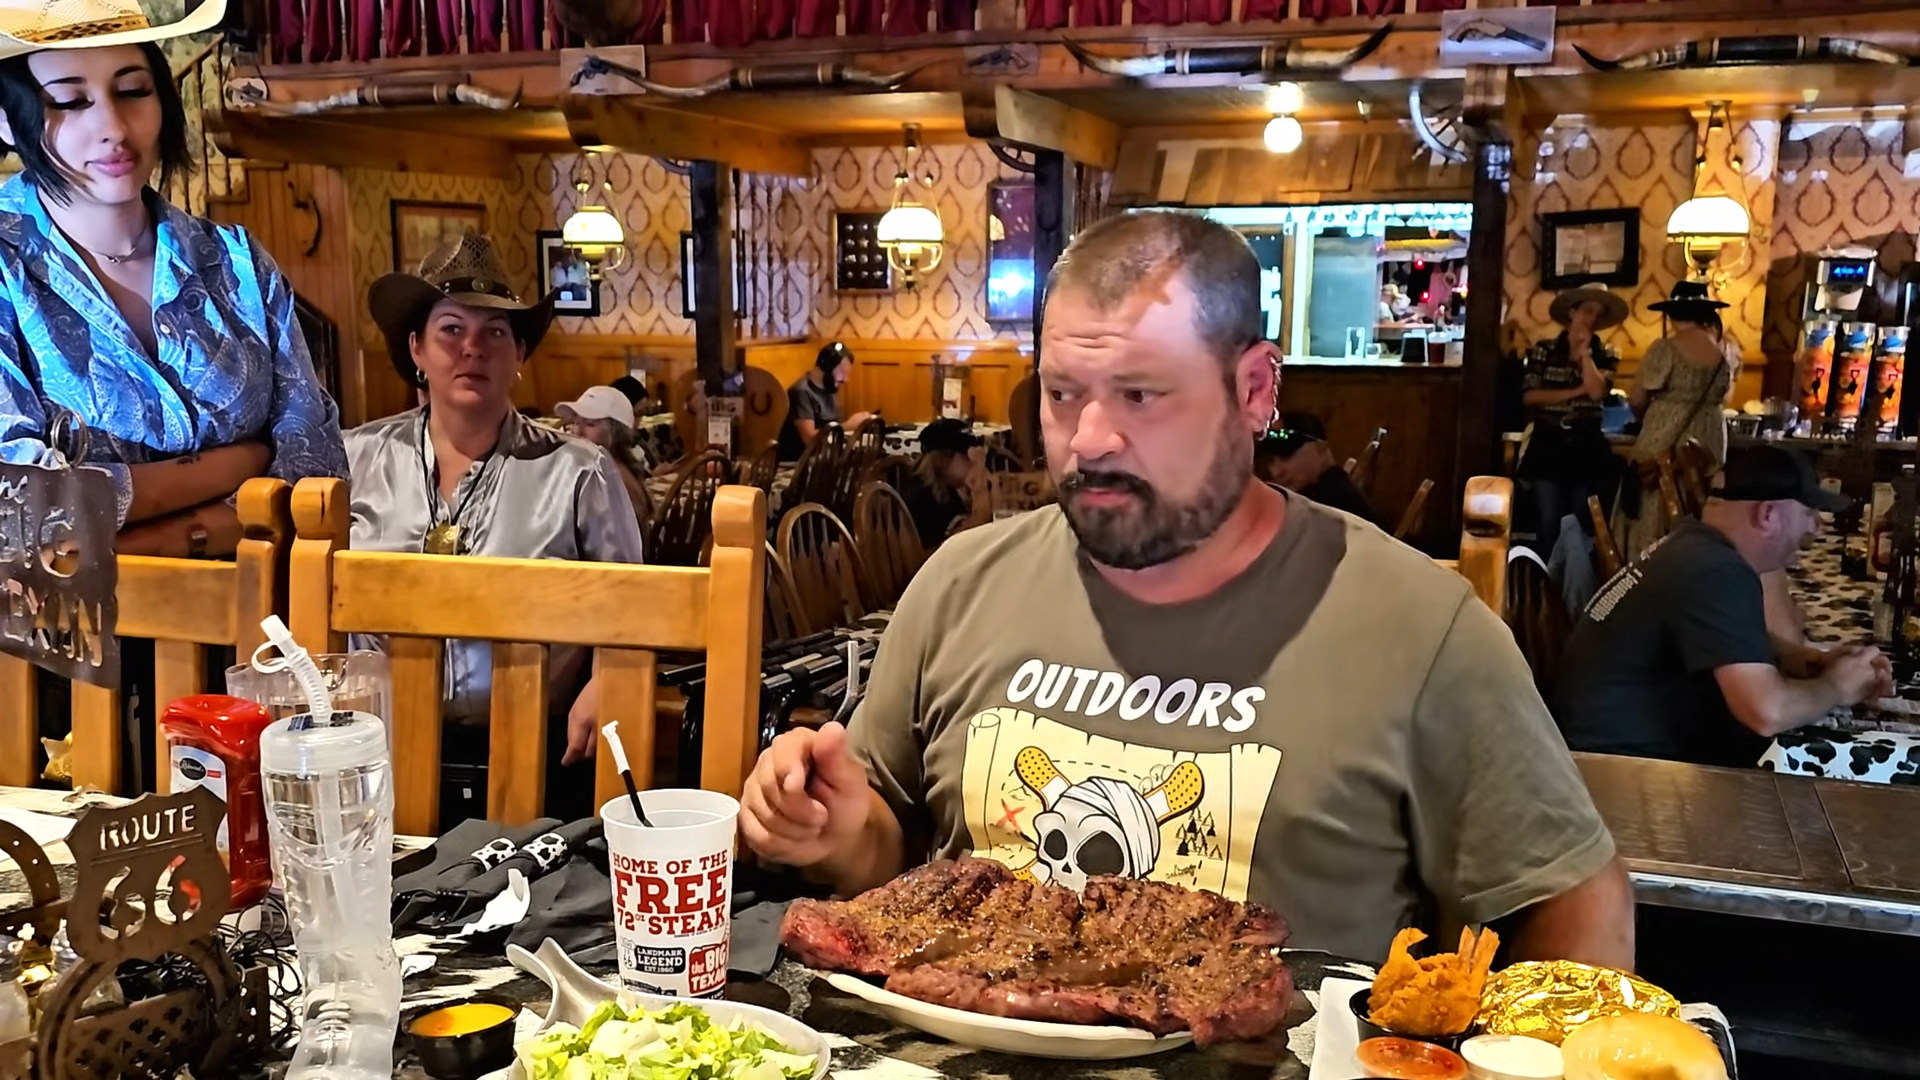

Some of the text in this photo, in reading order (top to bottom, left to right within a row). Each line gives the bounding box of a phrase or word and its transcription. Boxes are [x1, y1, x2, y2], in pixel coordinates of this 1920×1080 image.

[1007, 658, 1266, 733] OUTDOORS
[100, 804, 195, 851] ROUTE
[613, 849, 728, 875] HOME OF THE
[99, 854, 202, 941] 66
[614, 864, 727, 914] FREE
[648, 903, 726, 935] STEAK
[637, 947, 683, 957] LANDMARK
[638, 954, 684, 967] LEGEND
[705, 943, 726, 972] BIG
